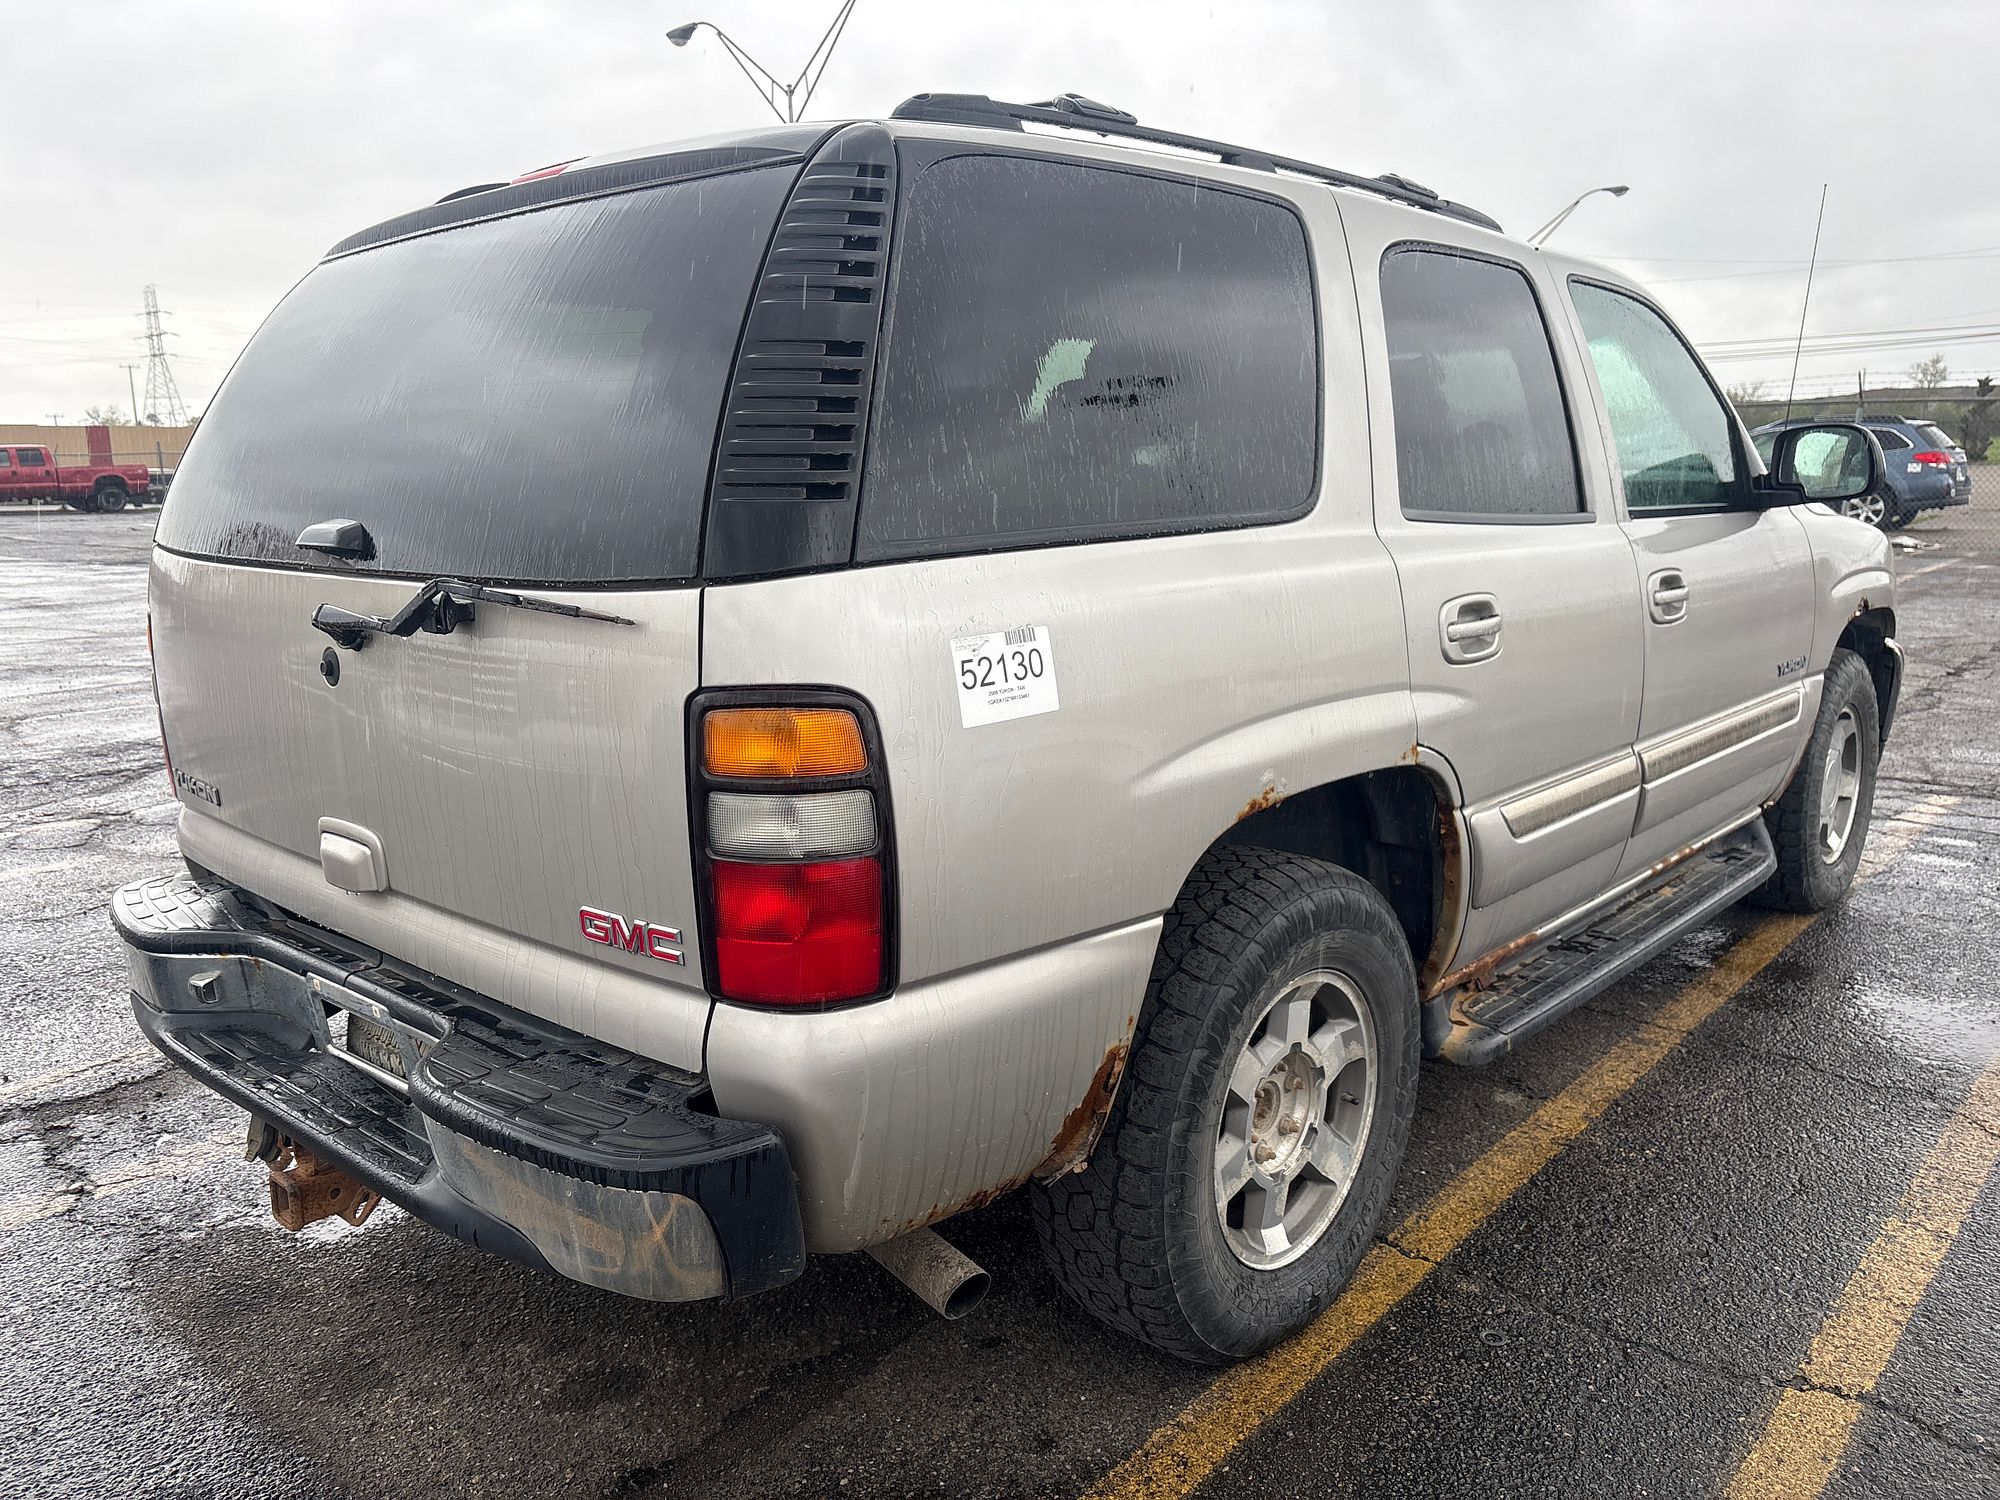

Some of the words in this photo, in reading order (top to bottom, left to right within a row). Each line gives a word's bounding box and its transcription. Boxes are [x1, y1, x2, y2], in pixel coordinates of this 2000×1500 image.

[961, 648, 1043, 690] 52130
[1777, 655, 1808, 677] YUKON
[173, 767, 222, 807] YUKON
[579, 905, 685, 967] GMC
